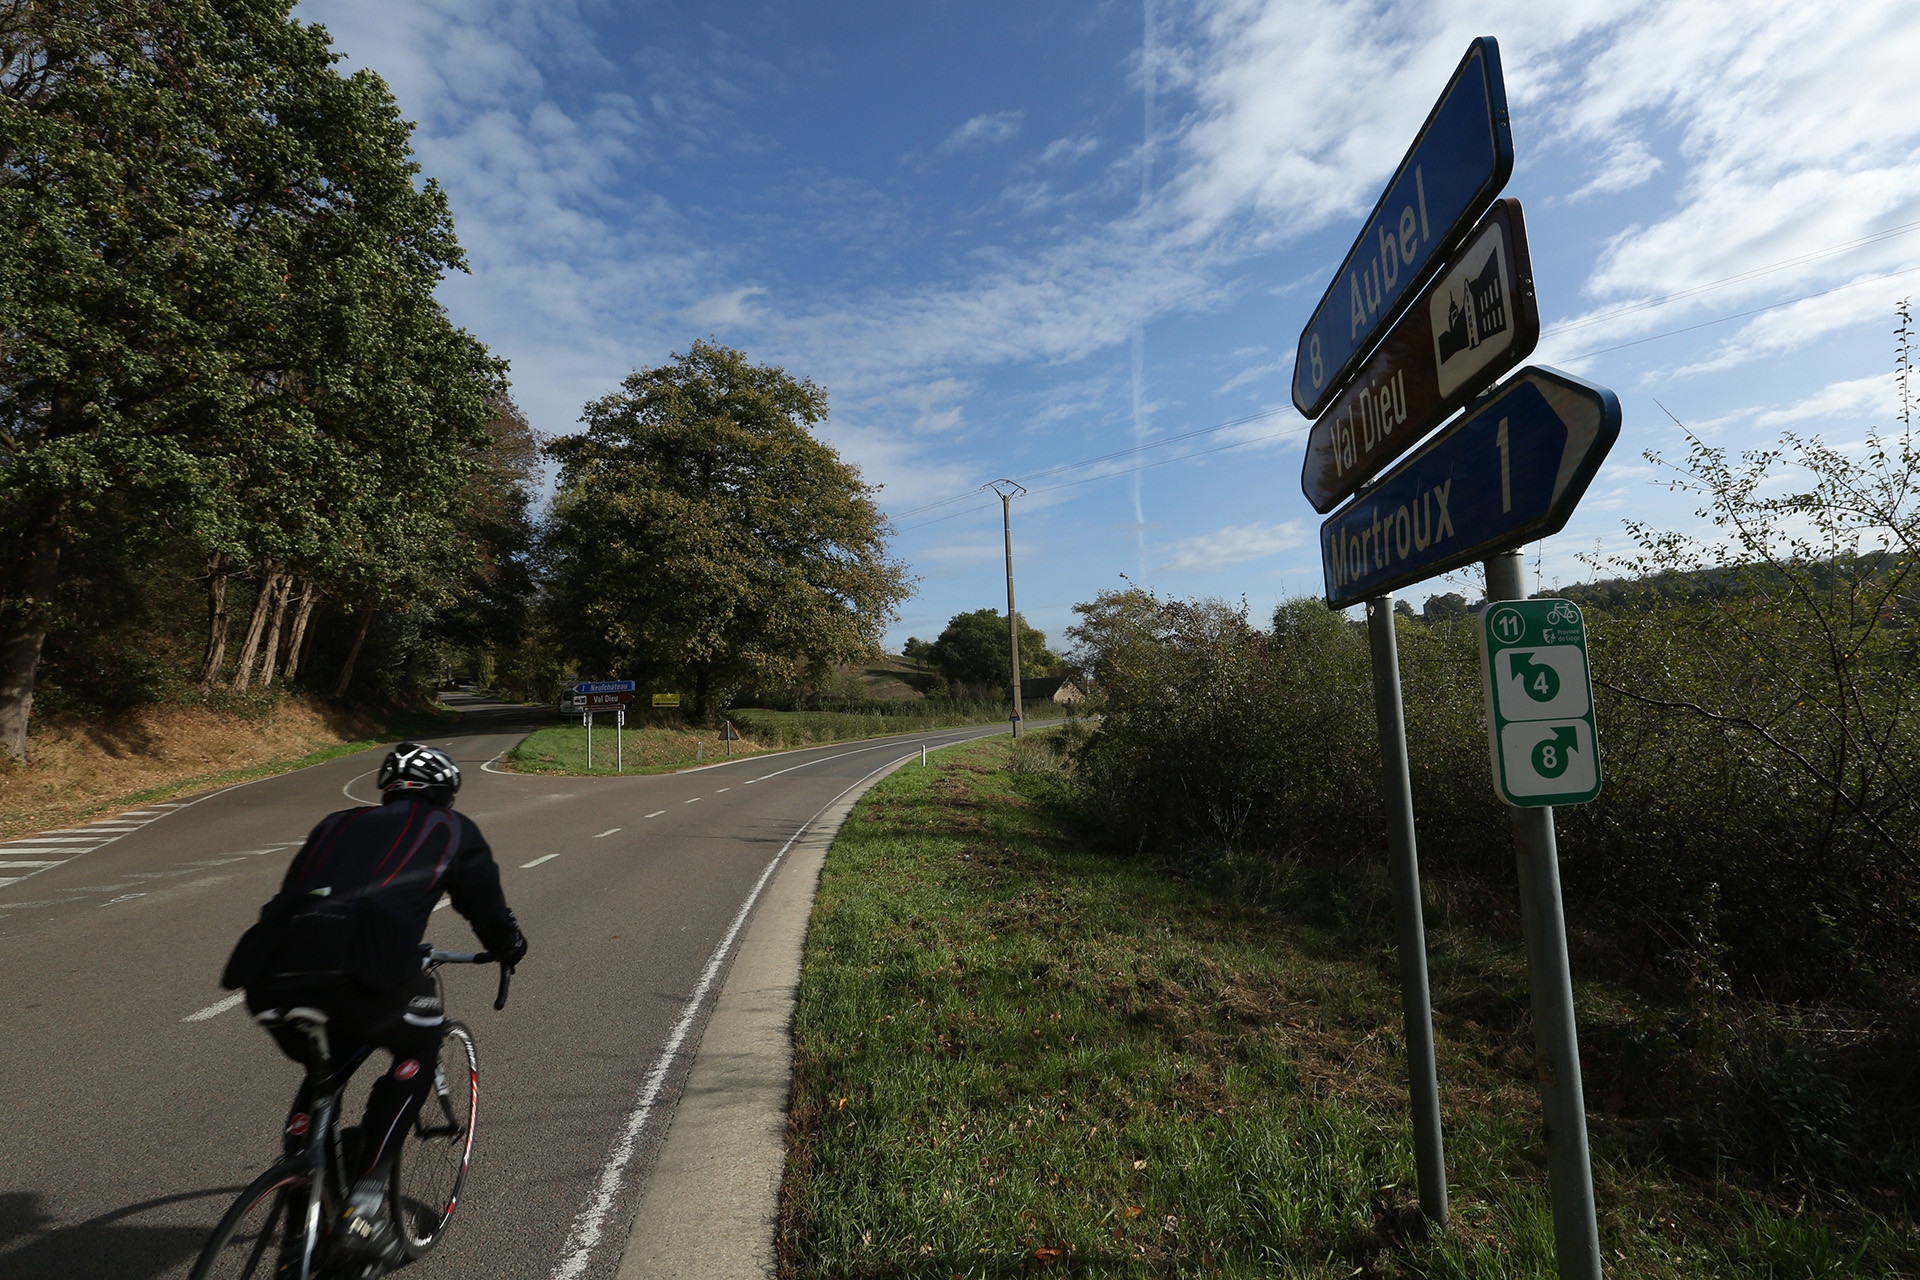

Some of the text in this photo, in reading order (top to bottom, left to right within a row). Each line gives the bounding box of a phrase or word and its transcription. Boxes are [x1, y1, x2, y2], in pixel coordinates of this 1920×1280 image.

[1310, 163, 1430, 390] 8 Aubel
[1330, 369, 1408, 478] Val Dieu
[1330, 416, 1512, 590] Mortroux 1
[1498, 615, 1519, 636] 11
[589, 682, 628, 692] Neufchâteau
[1533, 671, 1549, 694] 4
[593, 694, 619, 703] Val Dieu
[1542, 745, 1558, 769] 8
